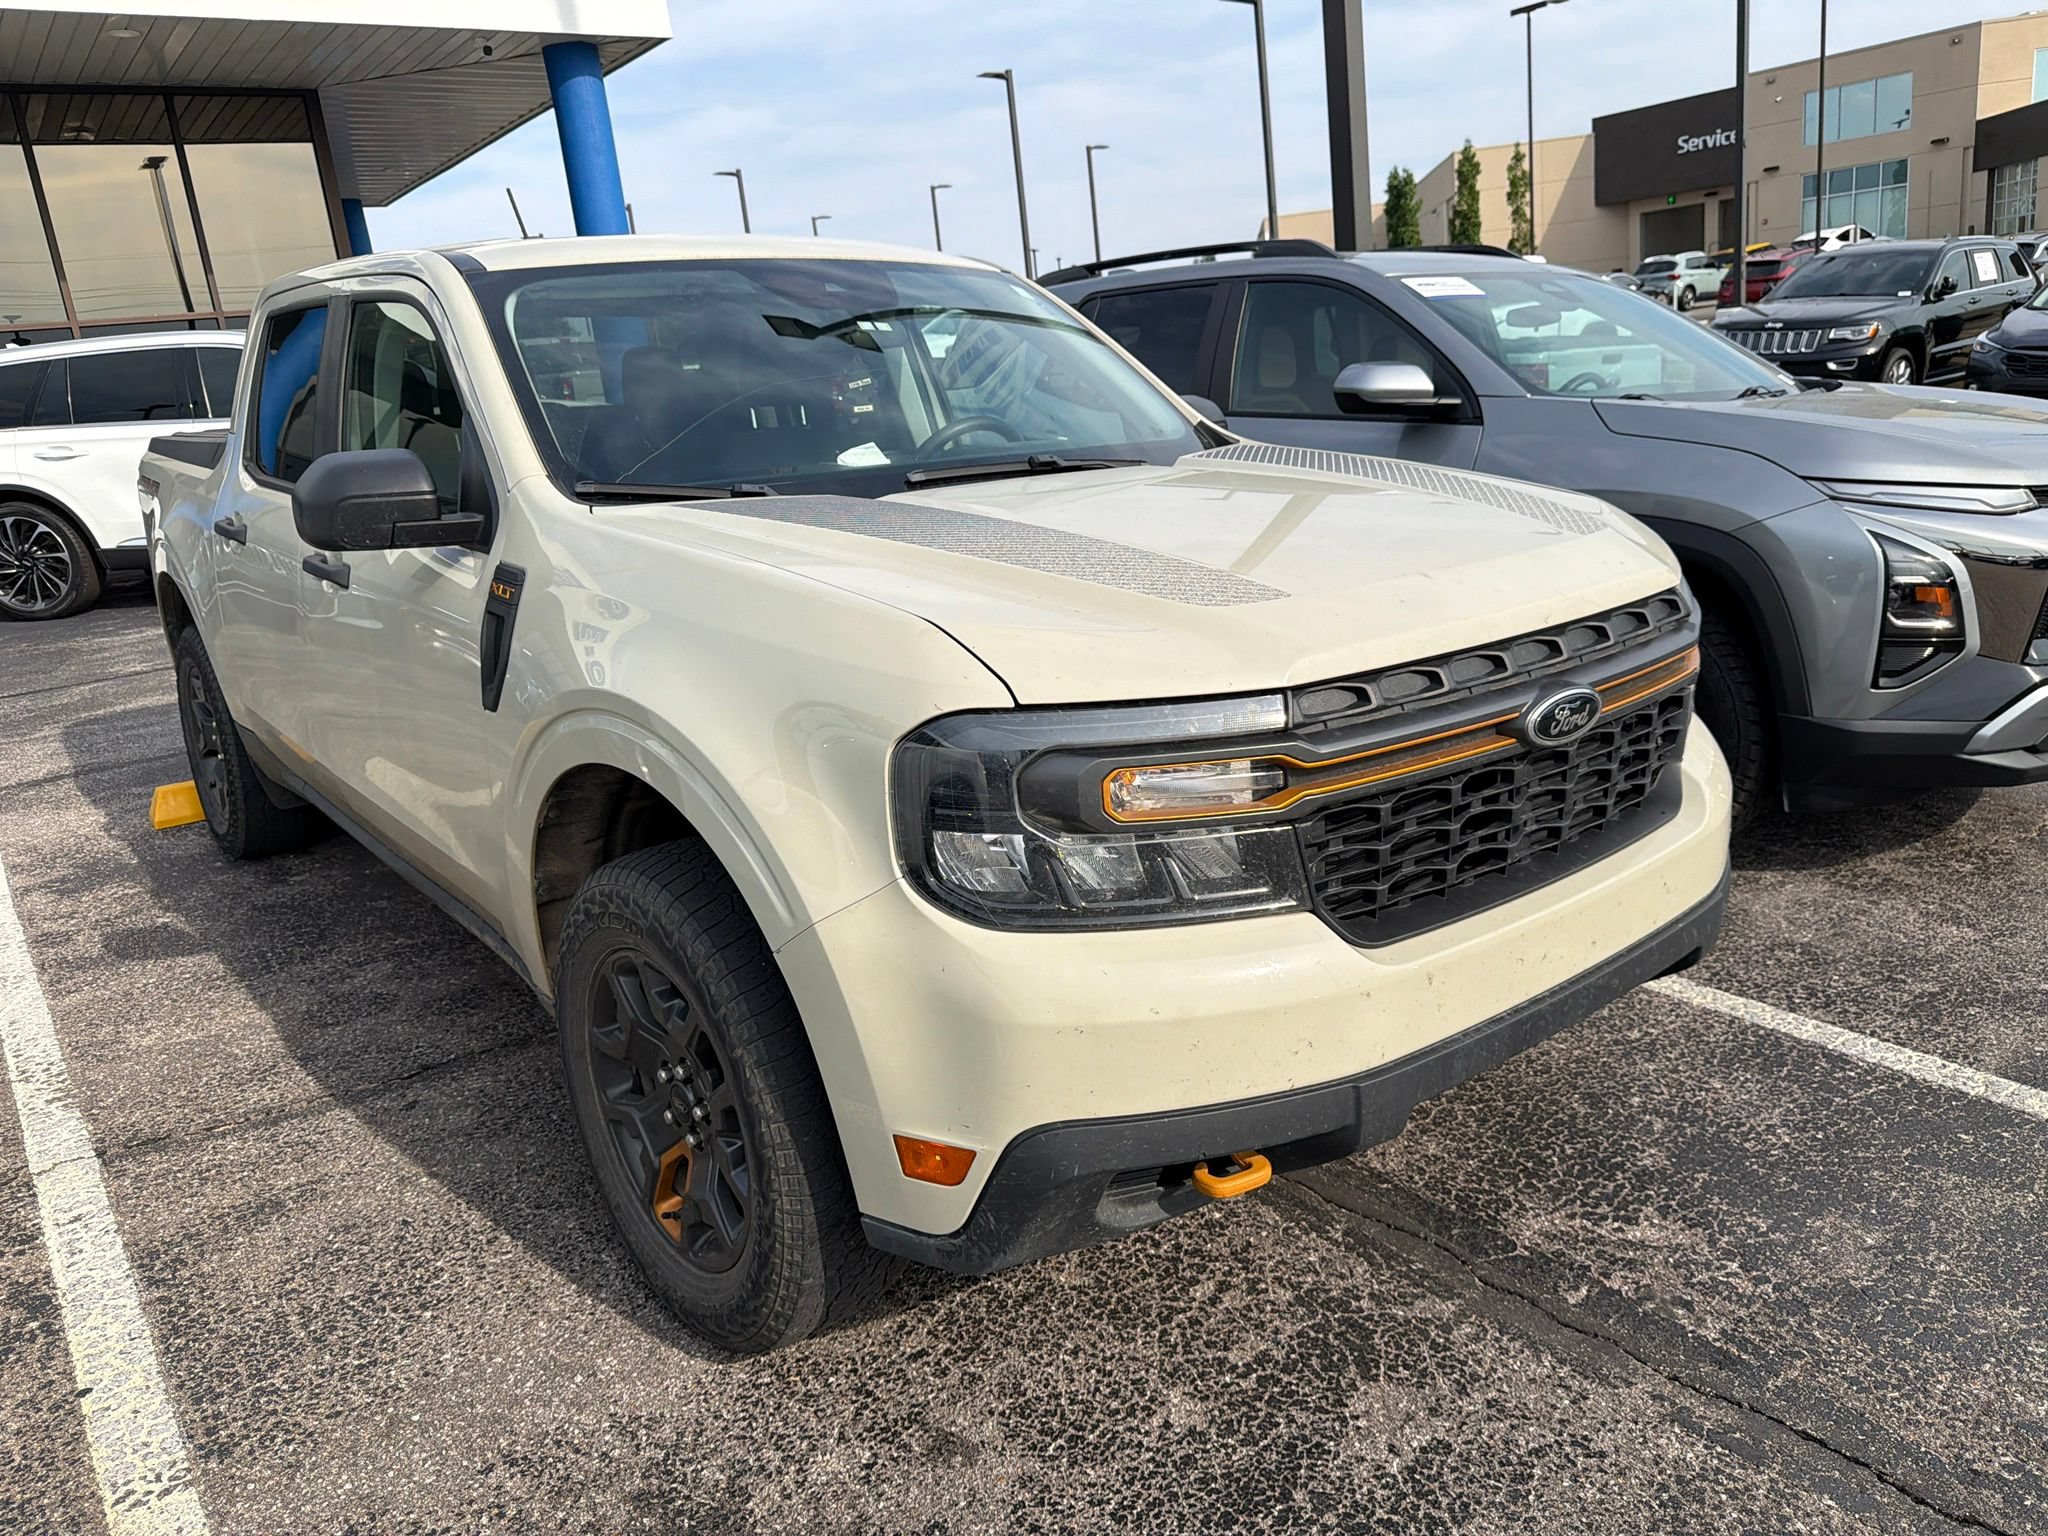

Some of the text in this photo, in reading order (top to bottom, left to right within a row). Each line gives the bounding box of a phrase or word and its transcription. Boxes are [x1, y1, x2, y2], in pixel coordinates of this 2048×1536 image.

[1677, 128, 1736, 154] Service
[491, 581, 516, 599] XLT
[1550, 700, 1591, 736] Ford
